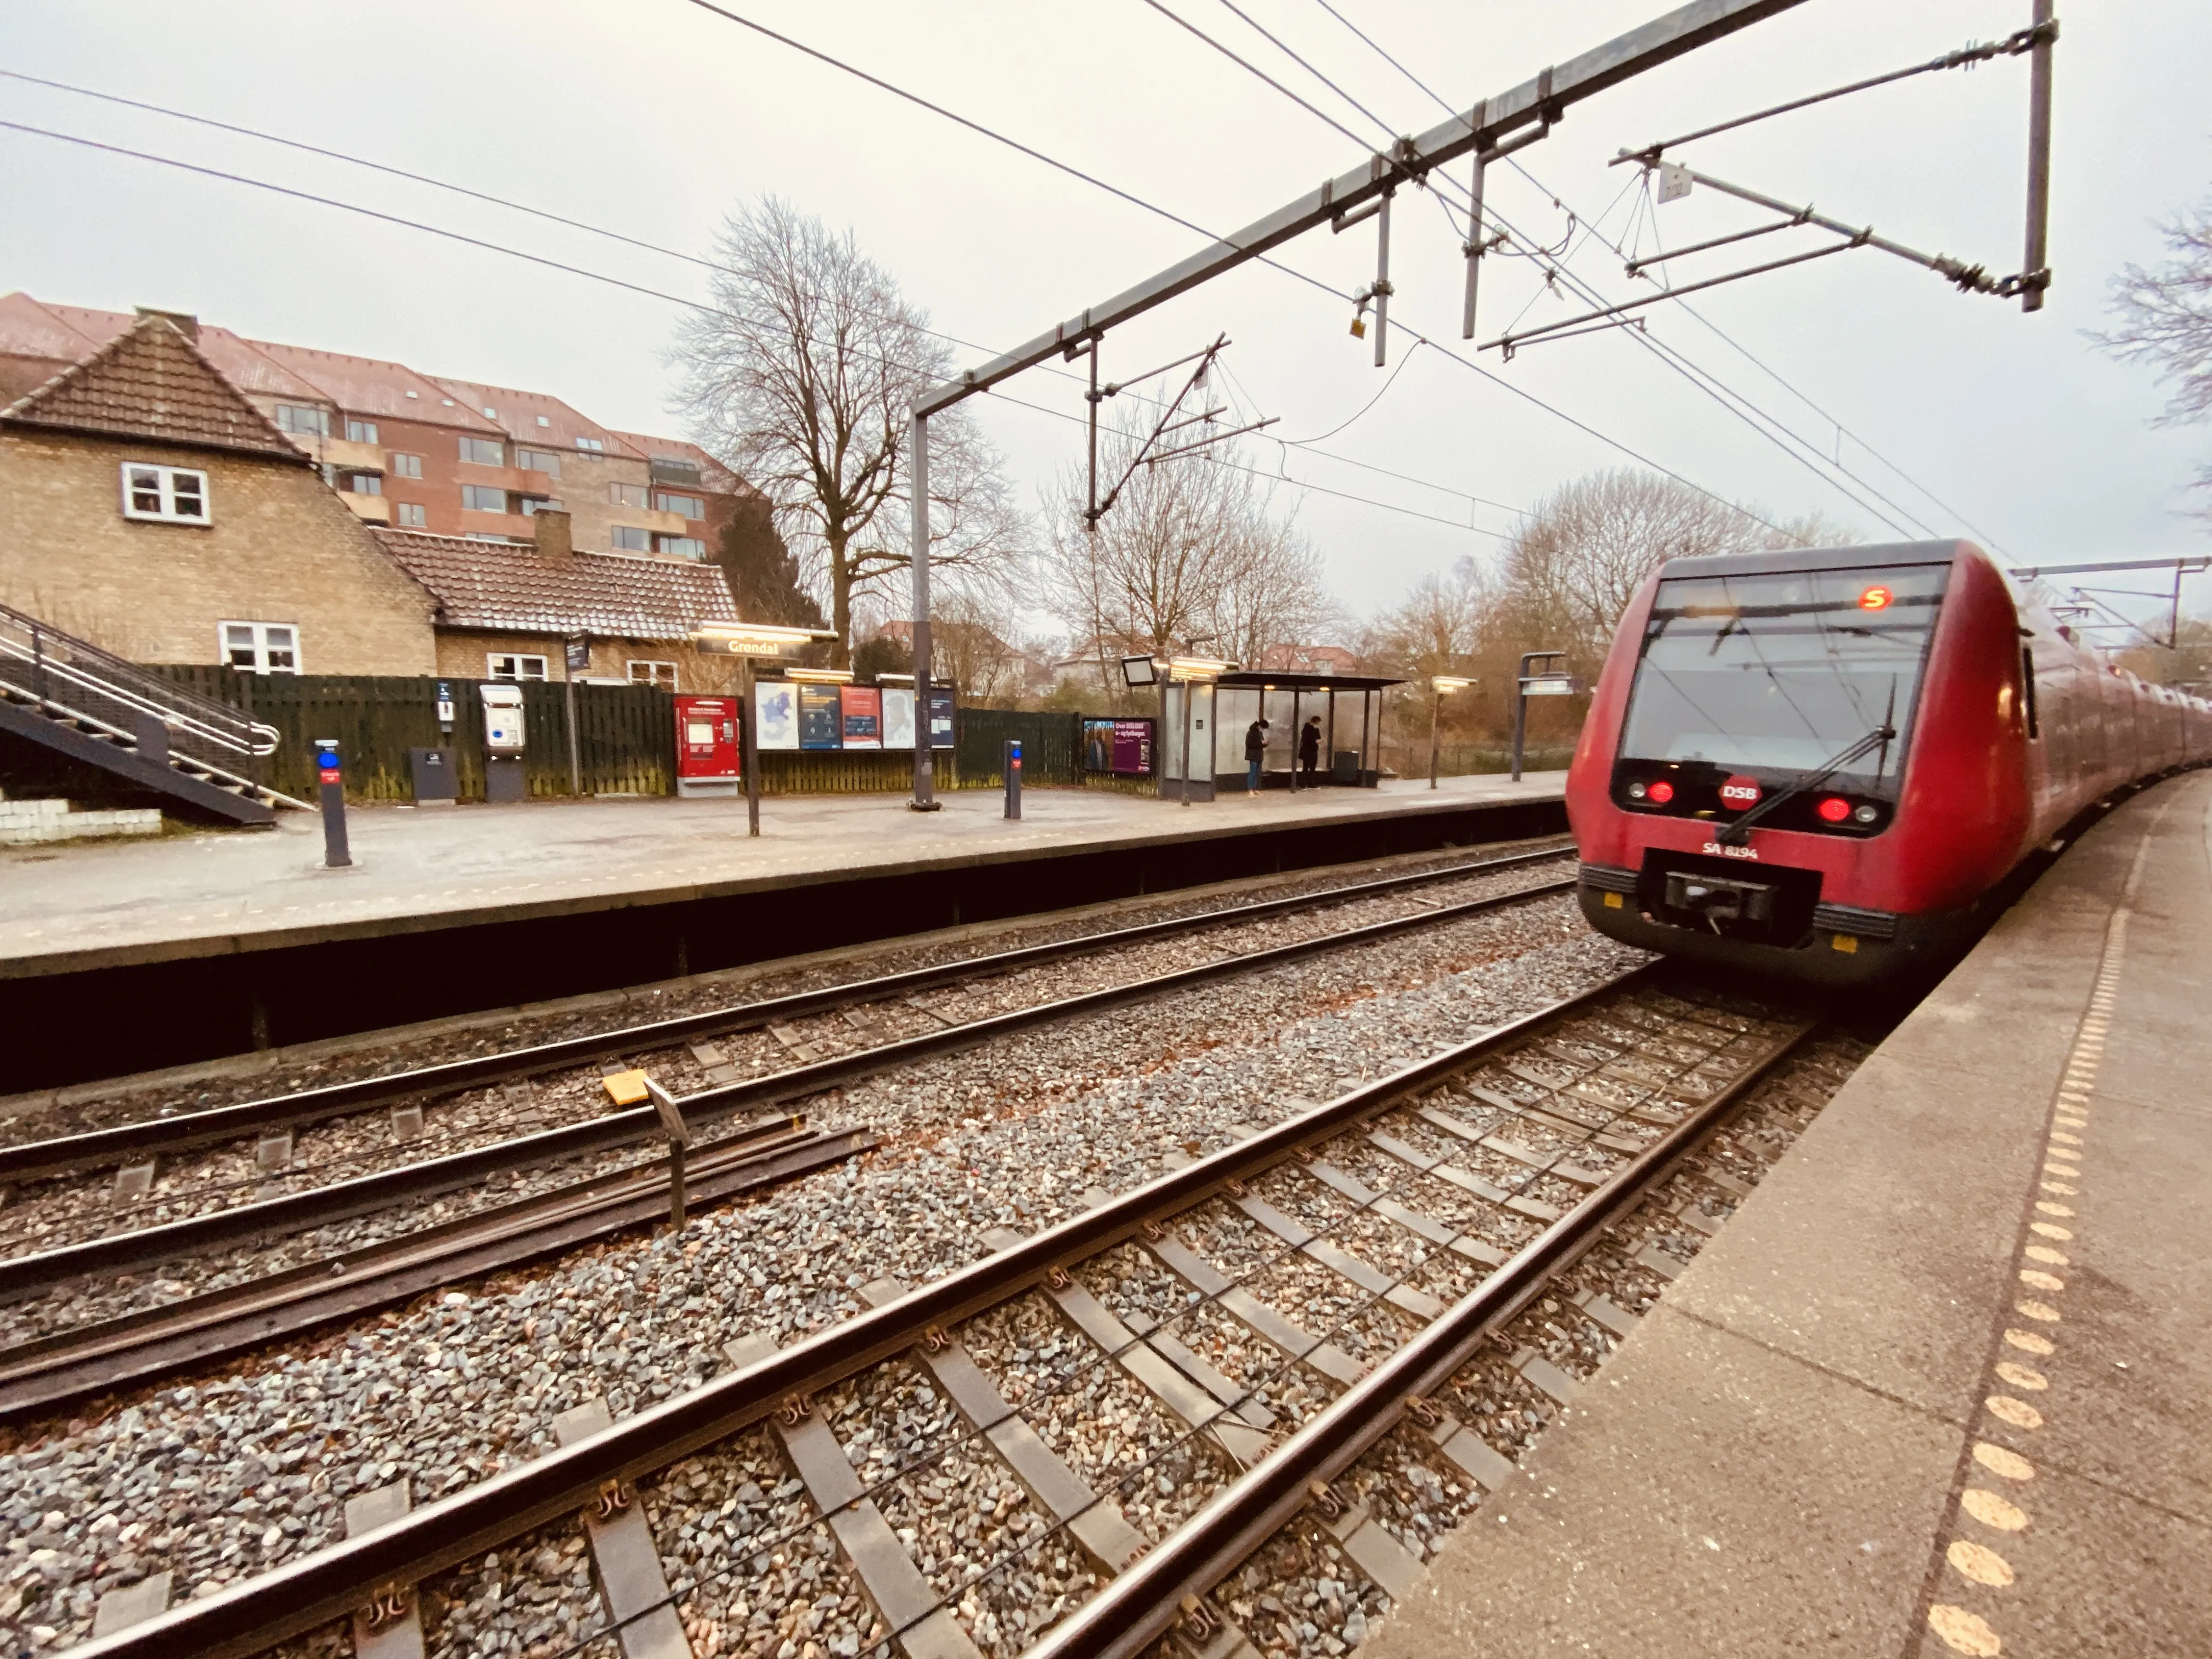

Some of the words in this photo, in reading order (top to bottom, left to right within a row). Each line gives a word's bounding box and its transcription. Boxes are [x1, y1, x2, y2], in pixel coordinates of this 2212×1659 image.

[1865, 590, 1886, 607] S
[728, 640, 779, 655] Grøndal
[1723, 786, 1757, 800] DSB
[1702, 843, 1722, 854] SA
[1724, 845, 1759, 859] 8194
